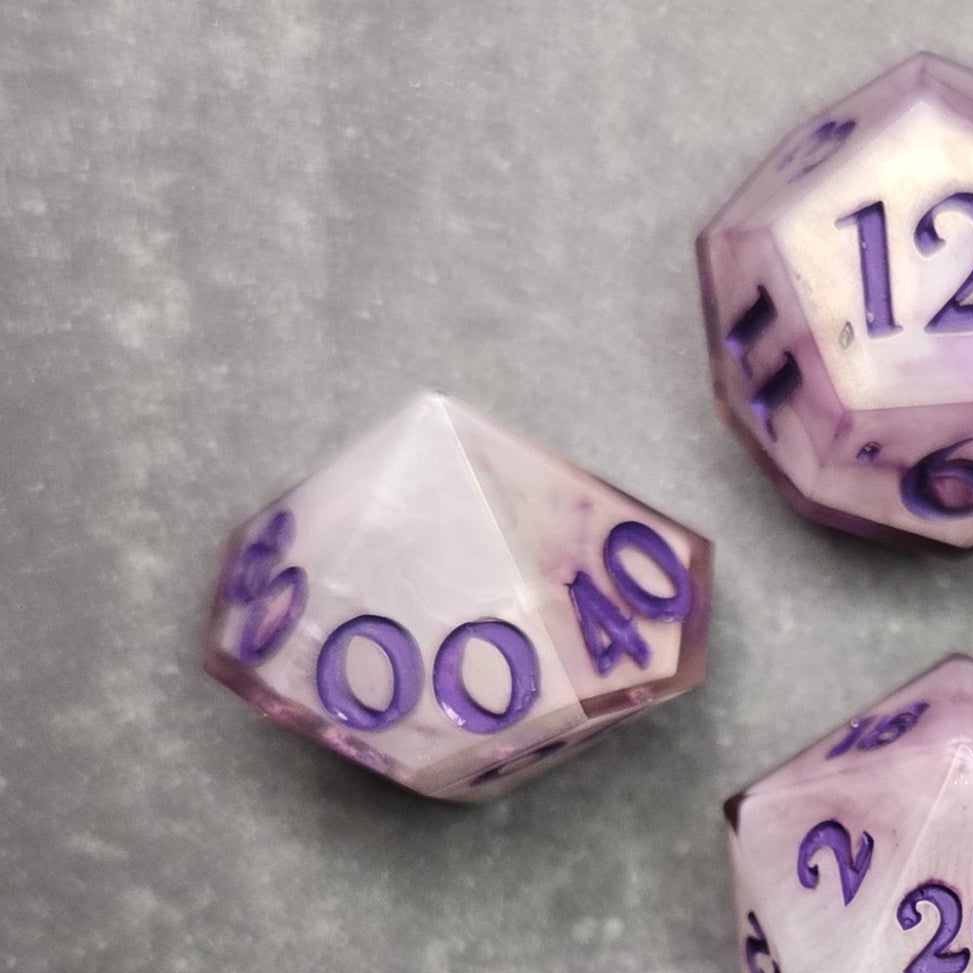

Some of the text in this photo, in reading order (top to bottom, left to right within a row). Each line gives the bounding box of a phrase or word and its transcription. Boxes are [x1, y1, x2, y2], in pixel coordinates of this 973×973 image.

[565, 520, 692, 677] 40
[315, 613, 542, 735] 00
[796, 818, 875, 907] 2
